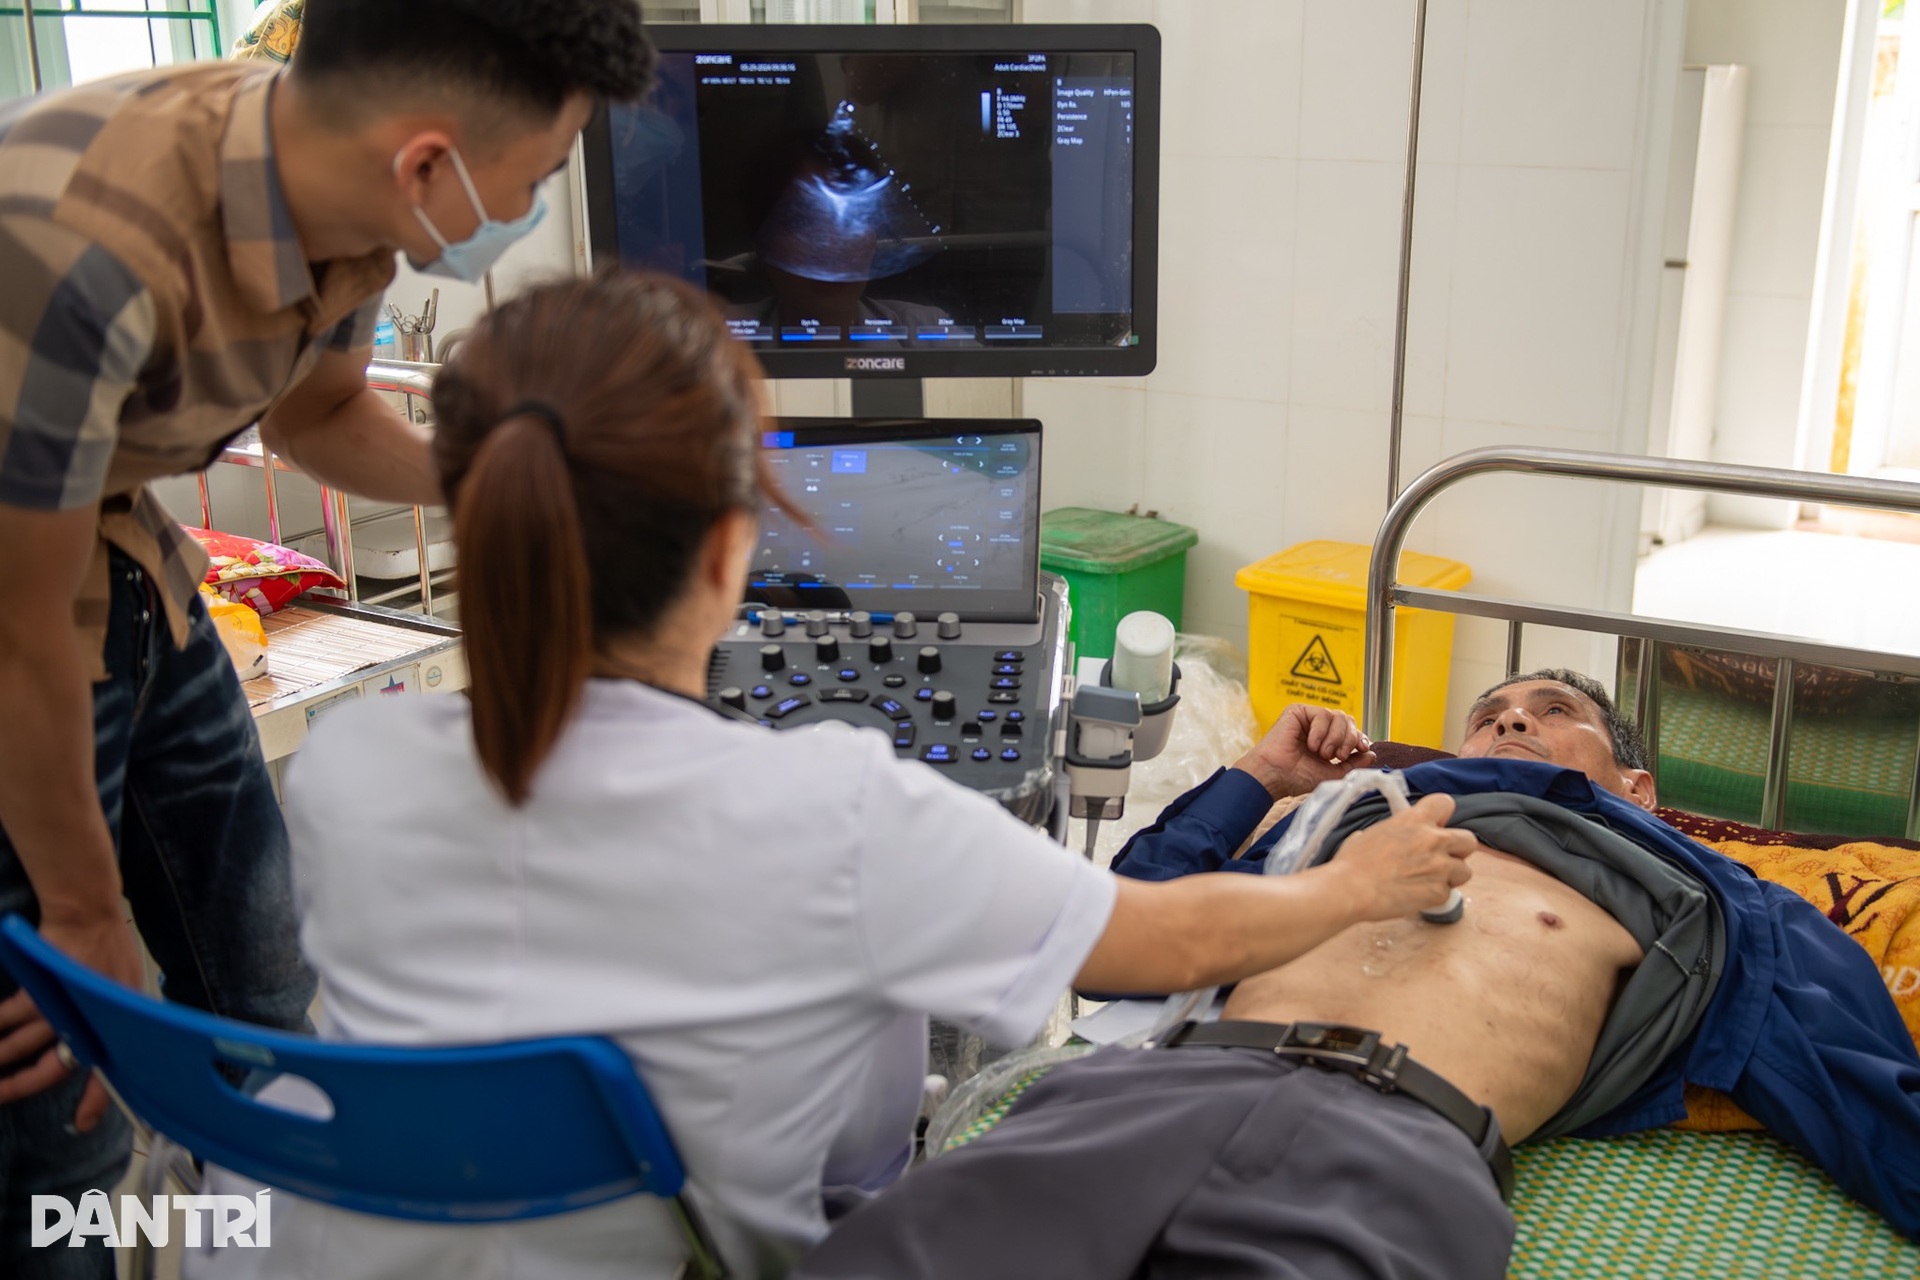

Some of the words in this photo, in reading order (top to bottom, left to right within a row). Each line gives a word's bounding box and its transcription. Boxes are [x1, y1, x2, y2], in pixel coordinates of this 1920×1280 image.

[1057, 88, 1074, 98] Image
[1075, 88, 1095, 98] Quality
[846, 357, 905, 370] zoncare
